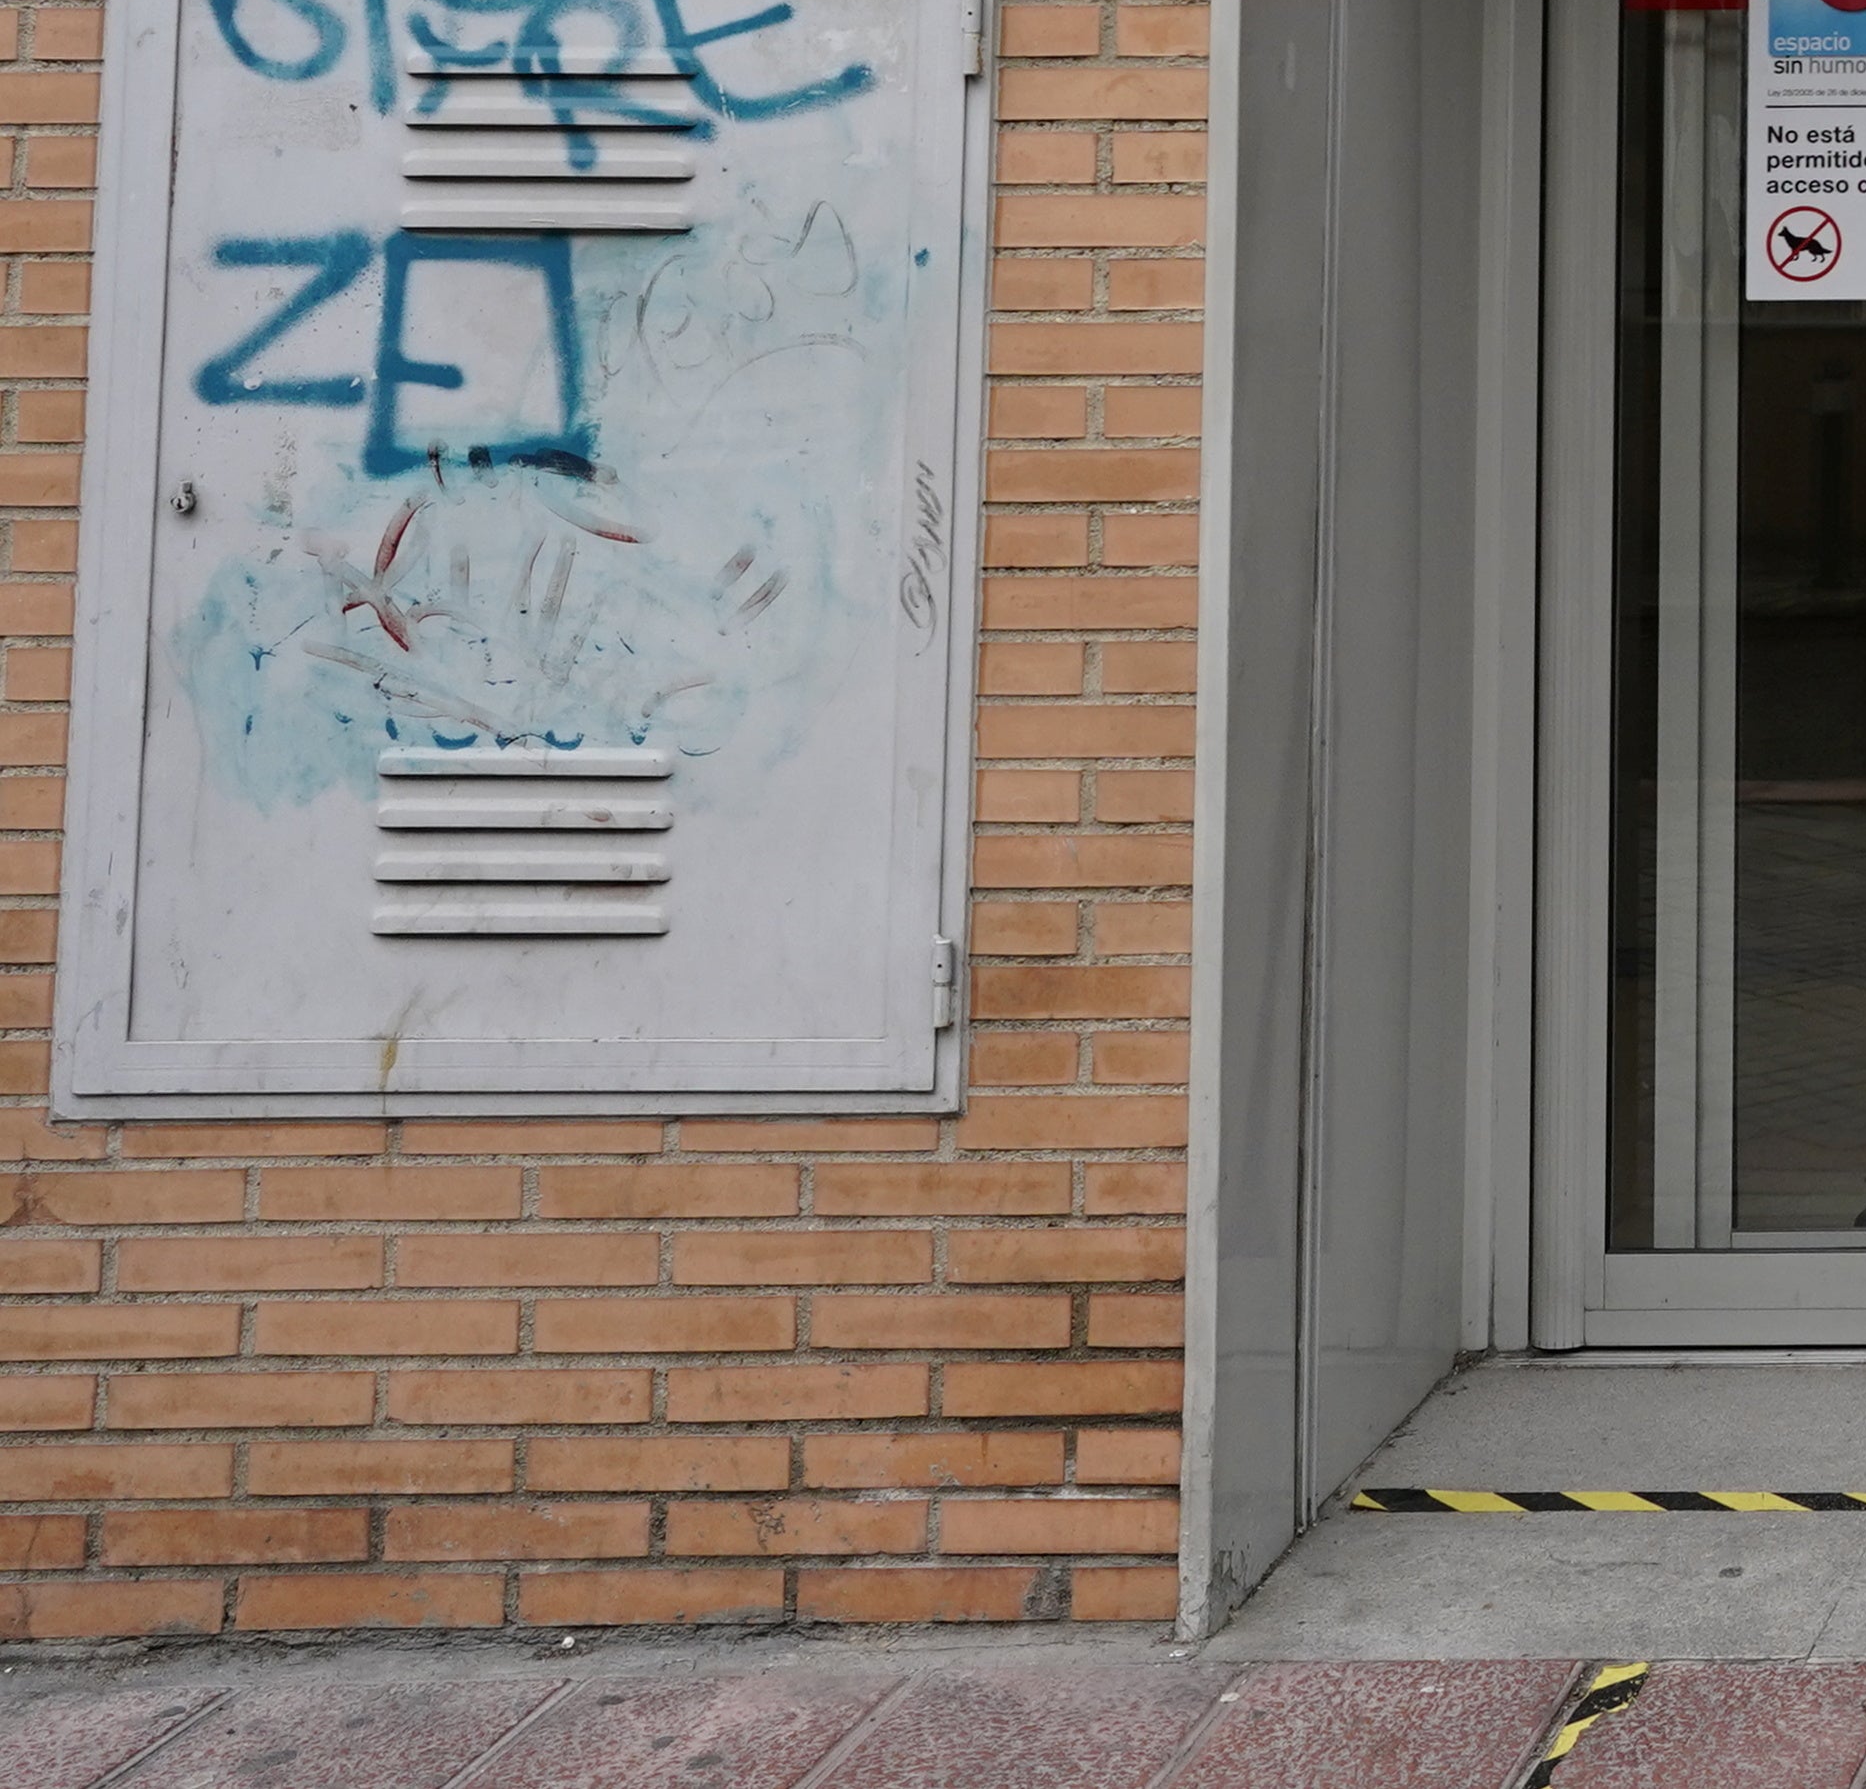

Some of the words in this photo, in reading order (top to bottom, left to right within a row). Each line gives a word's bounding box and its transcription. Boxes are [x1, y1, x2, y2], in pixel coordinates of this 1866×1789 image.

[1774, 33, 1850, 56] espacio
[1773, 57, 1804, 75] sin
[1768, 126, 1798, 143] No
[1807, 126, 1854, 143] está
[1767, 180, 1848, 193] acceso
